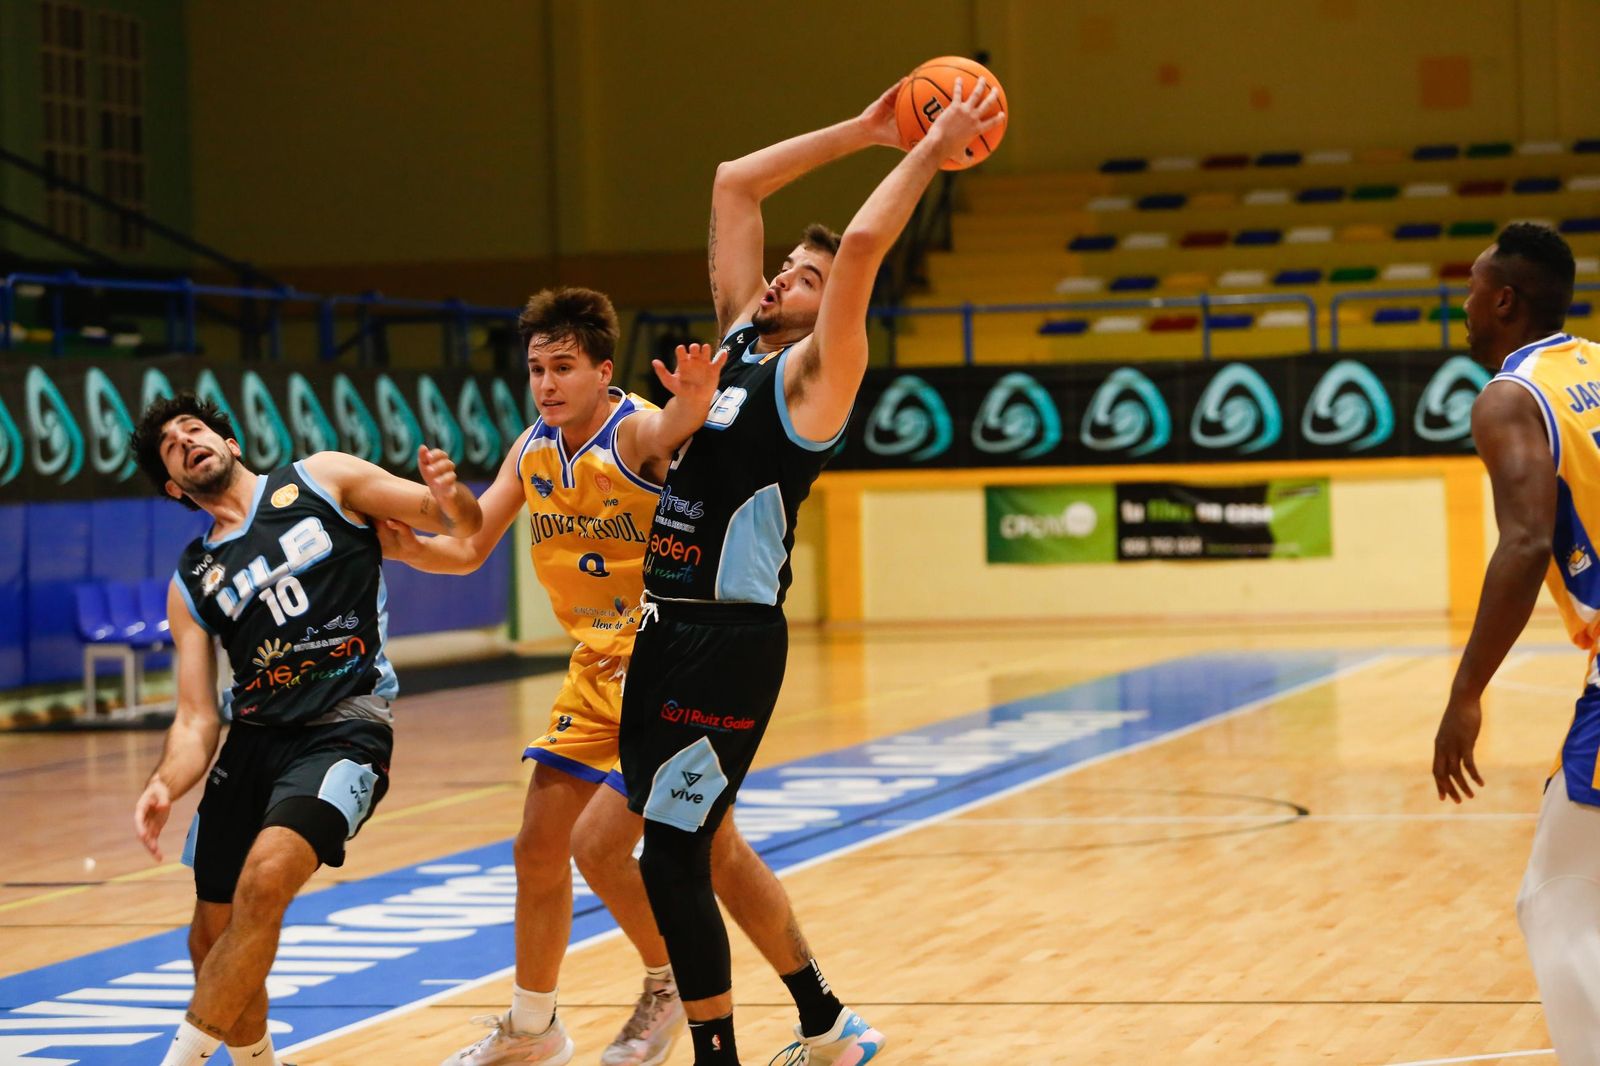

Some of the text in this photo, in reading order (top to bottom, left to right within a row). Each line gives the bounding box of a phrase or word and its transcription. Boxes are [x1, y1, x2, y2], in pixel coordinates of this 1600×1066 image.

[259, 576, 310, 627] 10
[691, 709, 720, 726] Ruiz
[671, 788, 704, 804] vive
